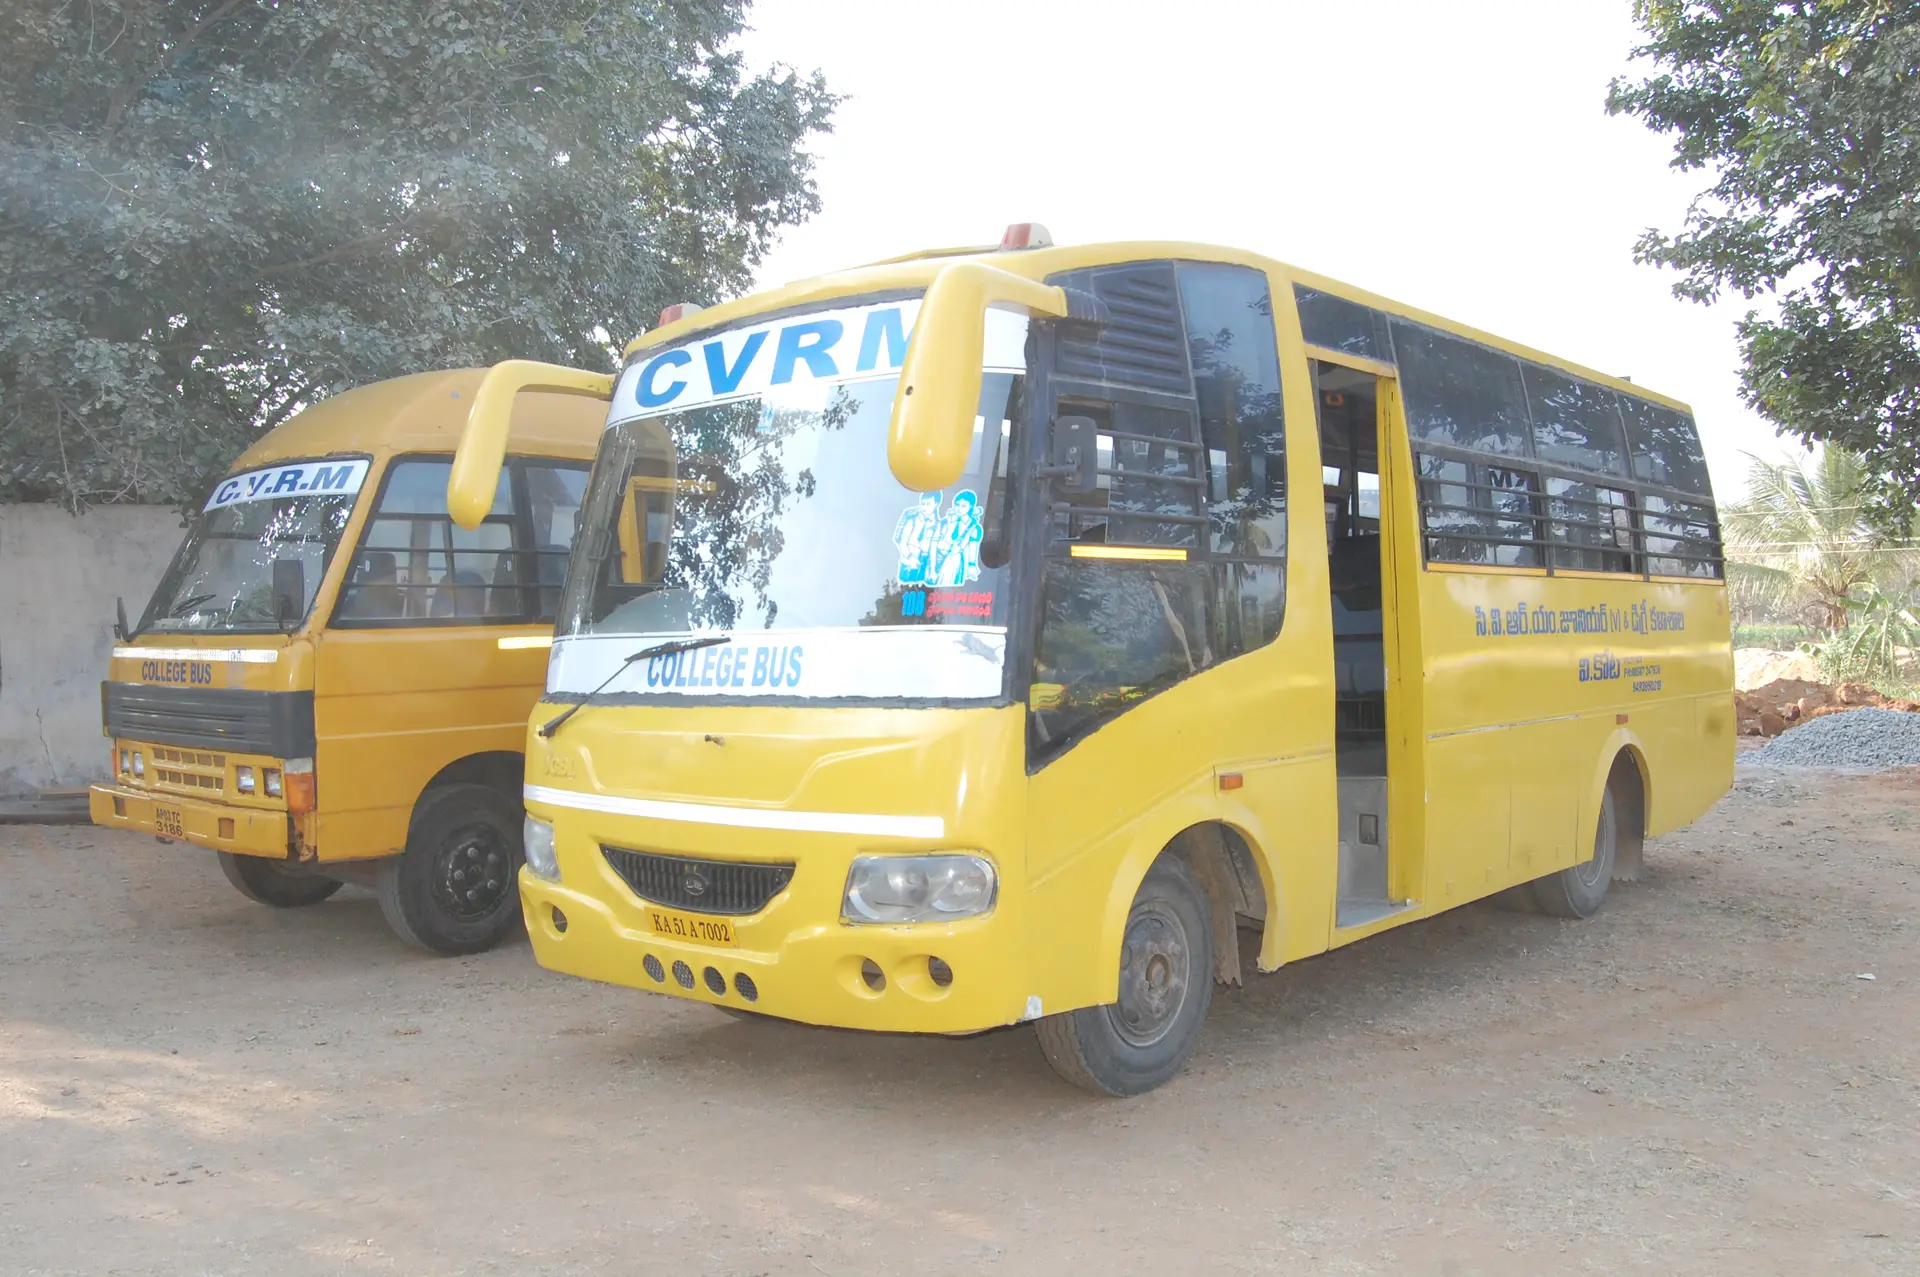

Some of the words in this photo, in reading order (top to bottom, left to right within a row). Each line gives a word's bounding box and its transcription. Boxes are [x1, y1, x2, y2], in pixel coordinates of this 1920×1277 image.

[215, 465, 354, 504] C.V.R.M
[141, 661, 186, 683] COLLEGE
[190, 662, 212, 685] BUS
[647, 646, 749, 687] COLLEGE
[751, 645, 803, 687] BUS
[156, 820, 183, 837] 3186
[653, 913, 672, 934] KA
[673, 917, 687, 936] 51
[690, 920, 699, 938] A
[699, 921, 730, 941] 7002
